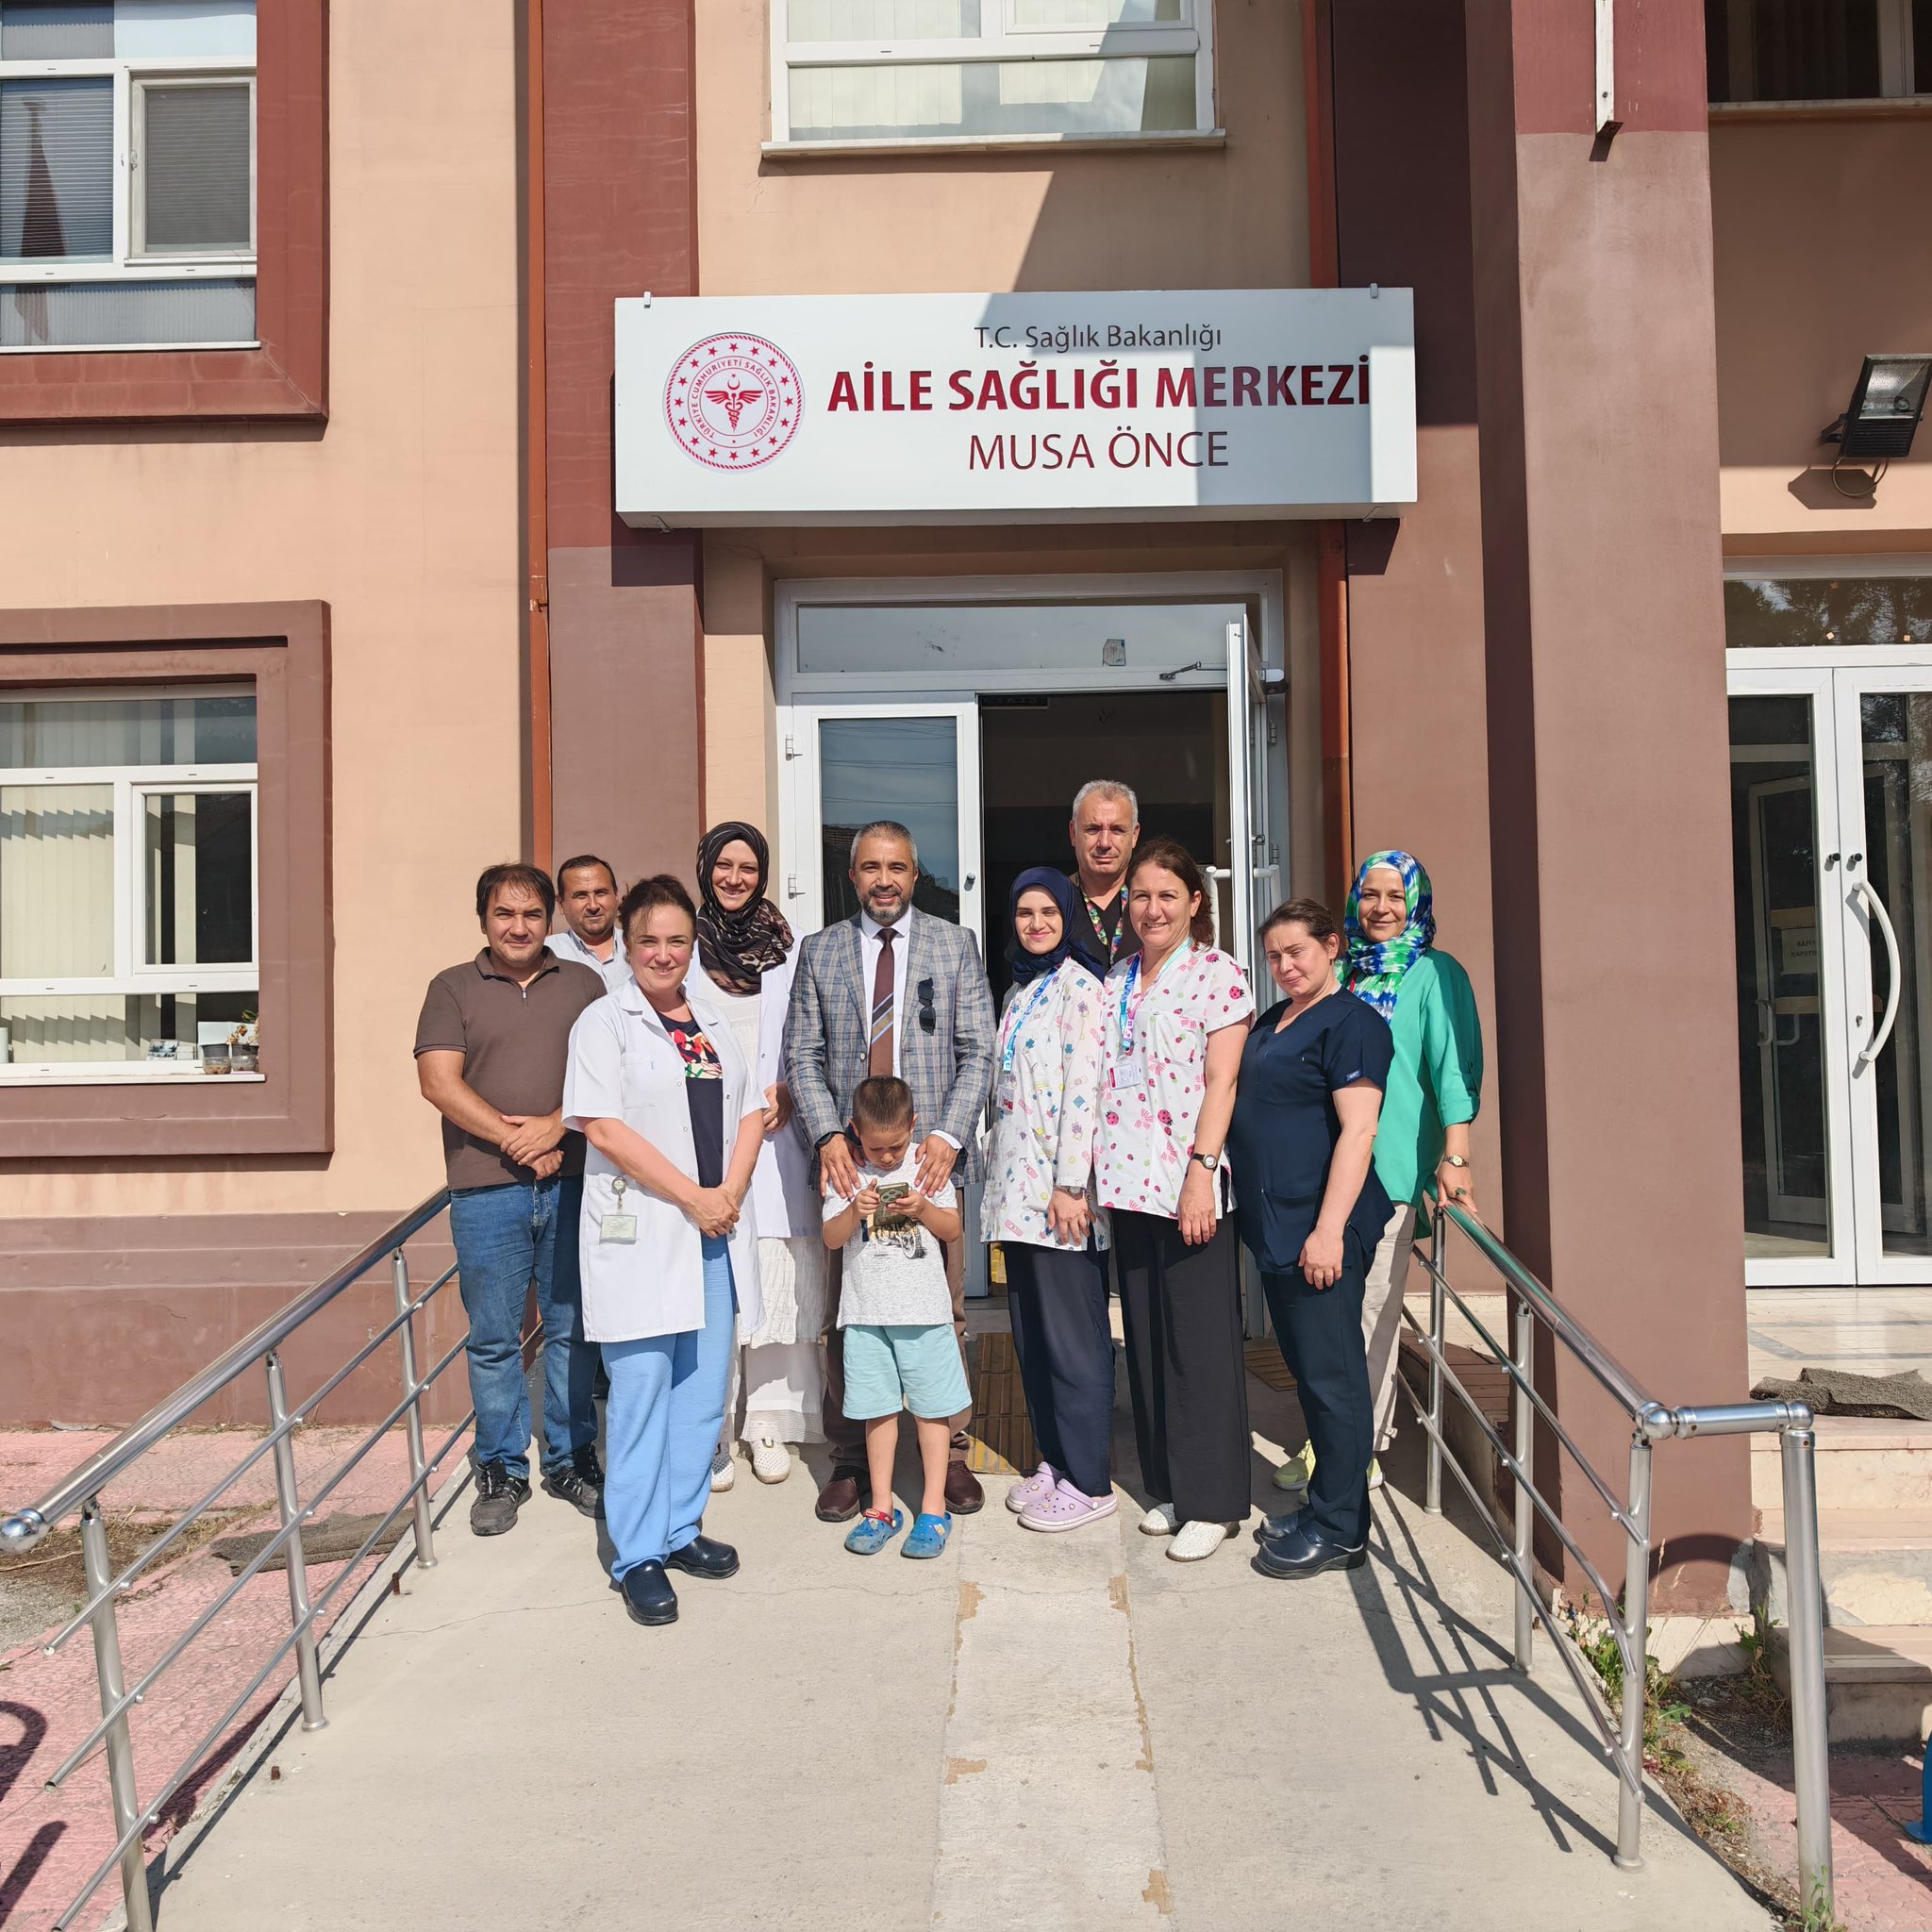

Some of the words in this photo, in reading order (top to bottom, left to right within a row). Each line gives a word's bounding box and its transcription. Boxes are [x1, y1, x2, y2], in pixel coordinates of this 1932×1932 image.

[974, 326, 1018, 348] T.C.
[1025, 325, 1100, 354] Sağlık
[1108, 324, 1222, 352] Bakanlığı
[743, 361, 772, 388] SAĞLIK
[826, 361, 933, 412] AİLE
[947, 359, 1138, 411] SAĞLIĞI
[1155, 354, 1371, 409] MERKEZİ
[691, 403, 715, 440] TÜRKİYE
[754, 389, 777, 438] BAKANLIĞI
[969, 434, 1095, 471] MUSA
[1108, 425, 1229, 469] ÖNCE
